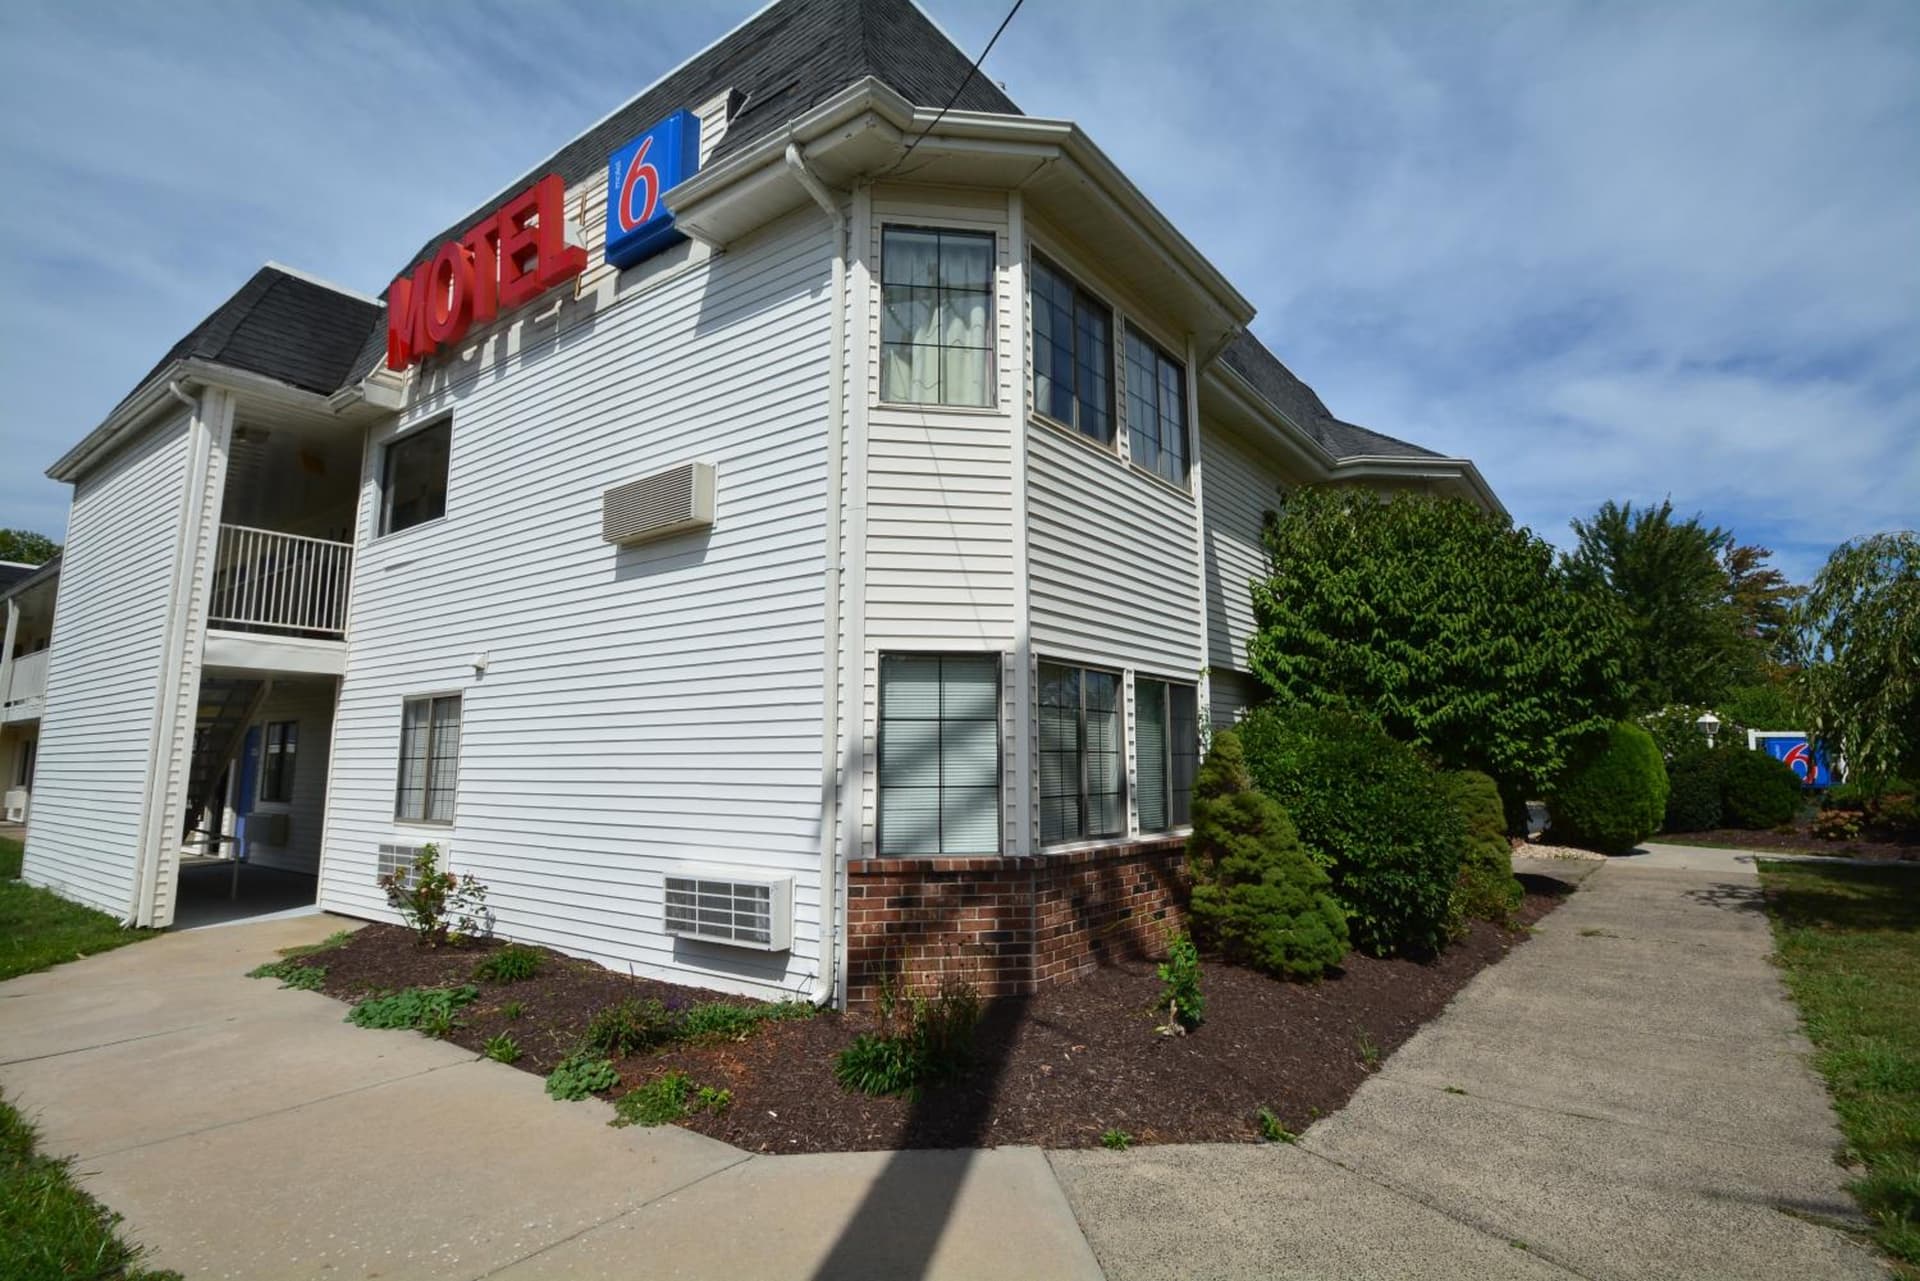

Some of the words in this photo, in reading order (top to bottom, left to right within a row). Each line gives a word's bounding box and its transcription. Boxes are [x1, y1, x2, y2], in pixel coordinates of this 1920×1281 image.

[618, 135, 659, 233] 6
[387, 173, 588, 372] MOTEL
[1782, 743, 1818, 785] 6
